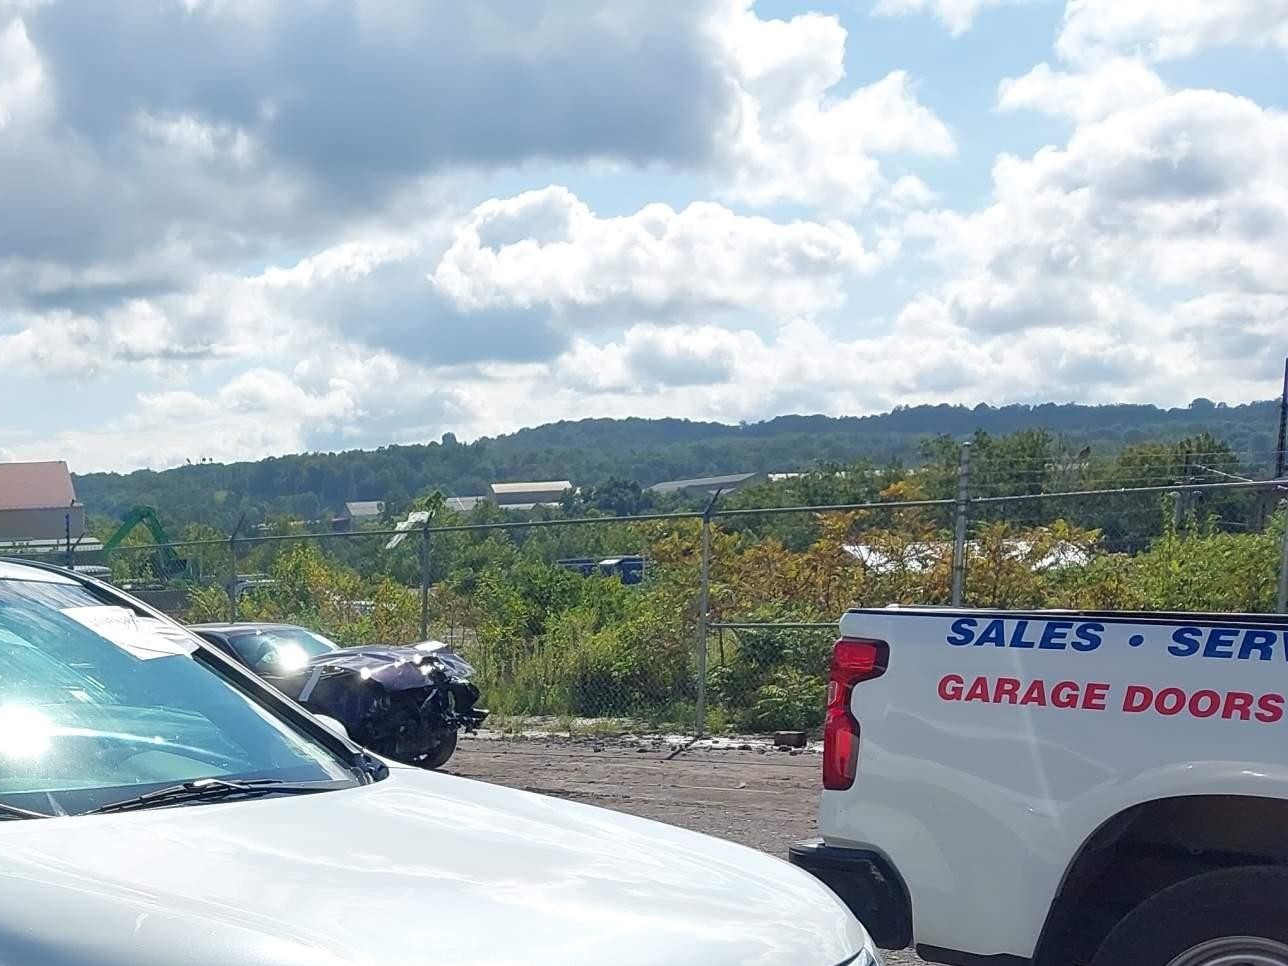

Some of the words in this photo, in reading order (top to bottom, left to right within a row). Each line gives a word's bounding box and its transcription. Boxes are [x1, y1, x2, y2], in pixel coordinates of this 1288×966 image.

[946, 617, 1105, 652] SALES
[1167, 627, 1288, 662] SER
[937, 674, 1110, 711] GARAGE
[1122, 685, 1285, 723] DOORS
